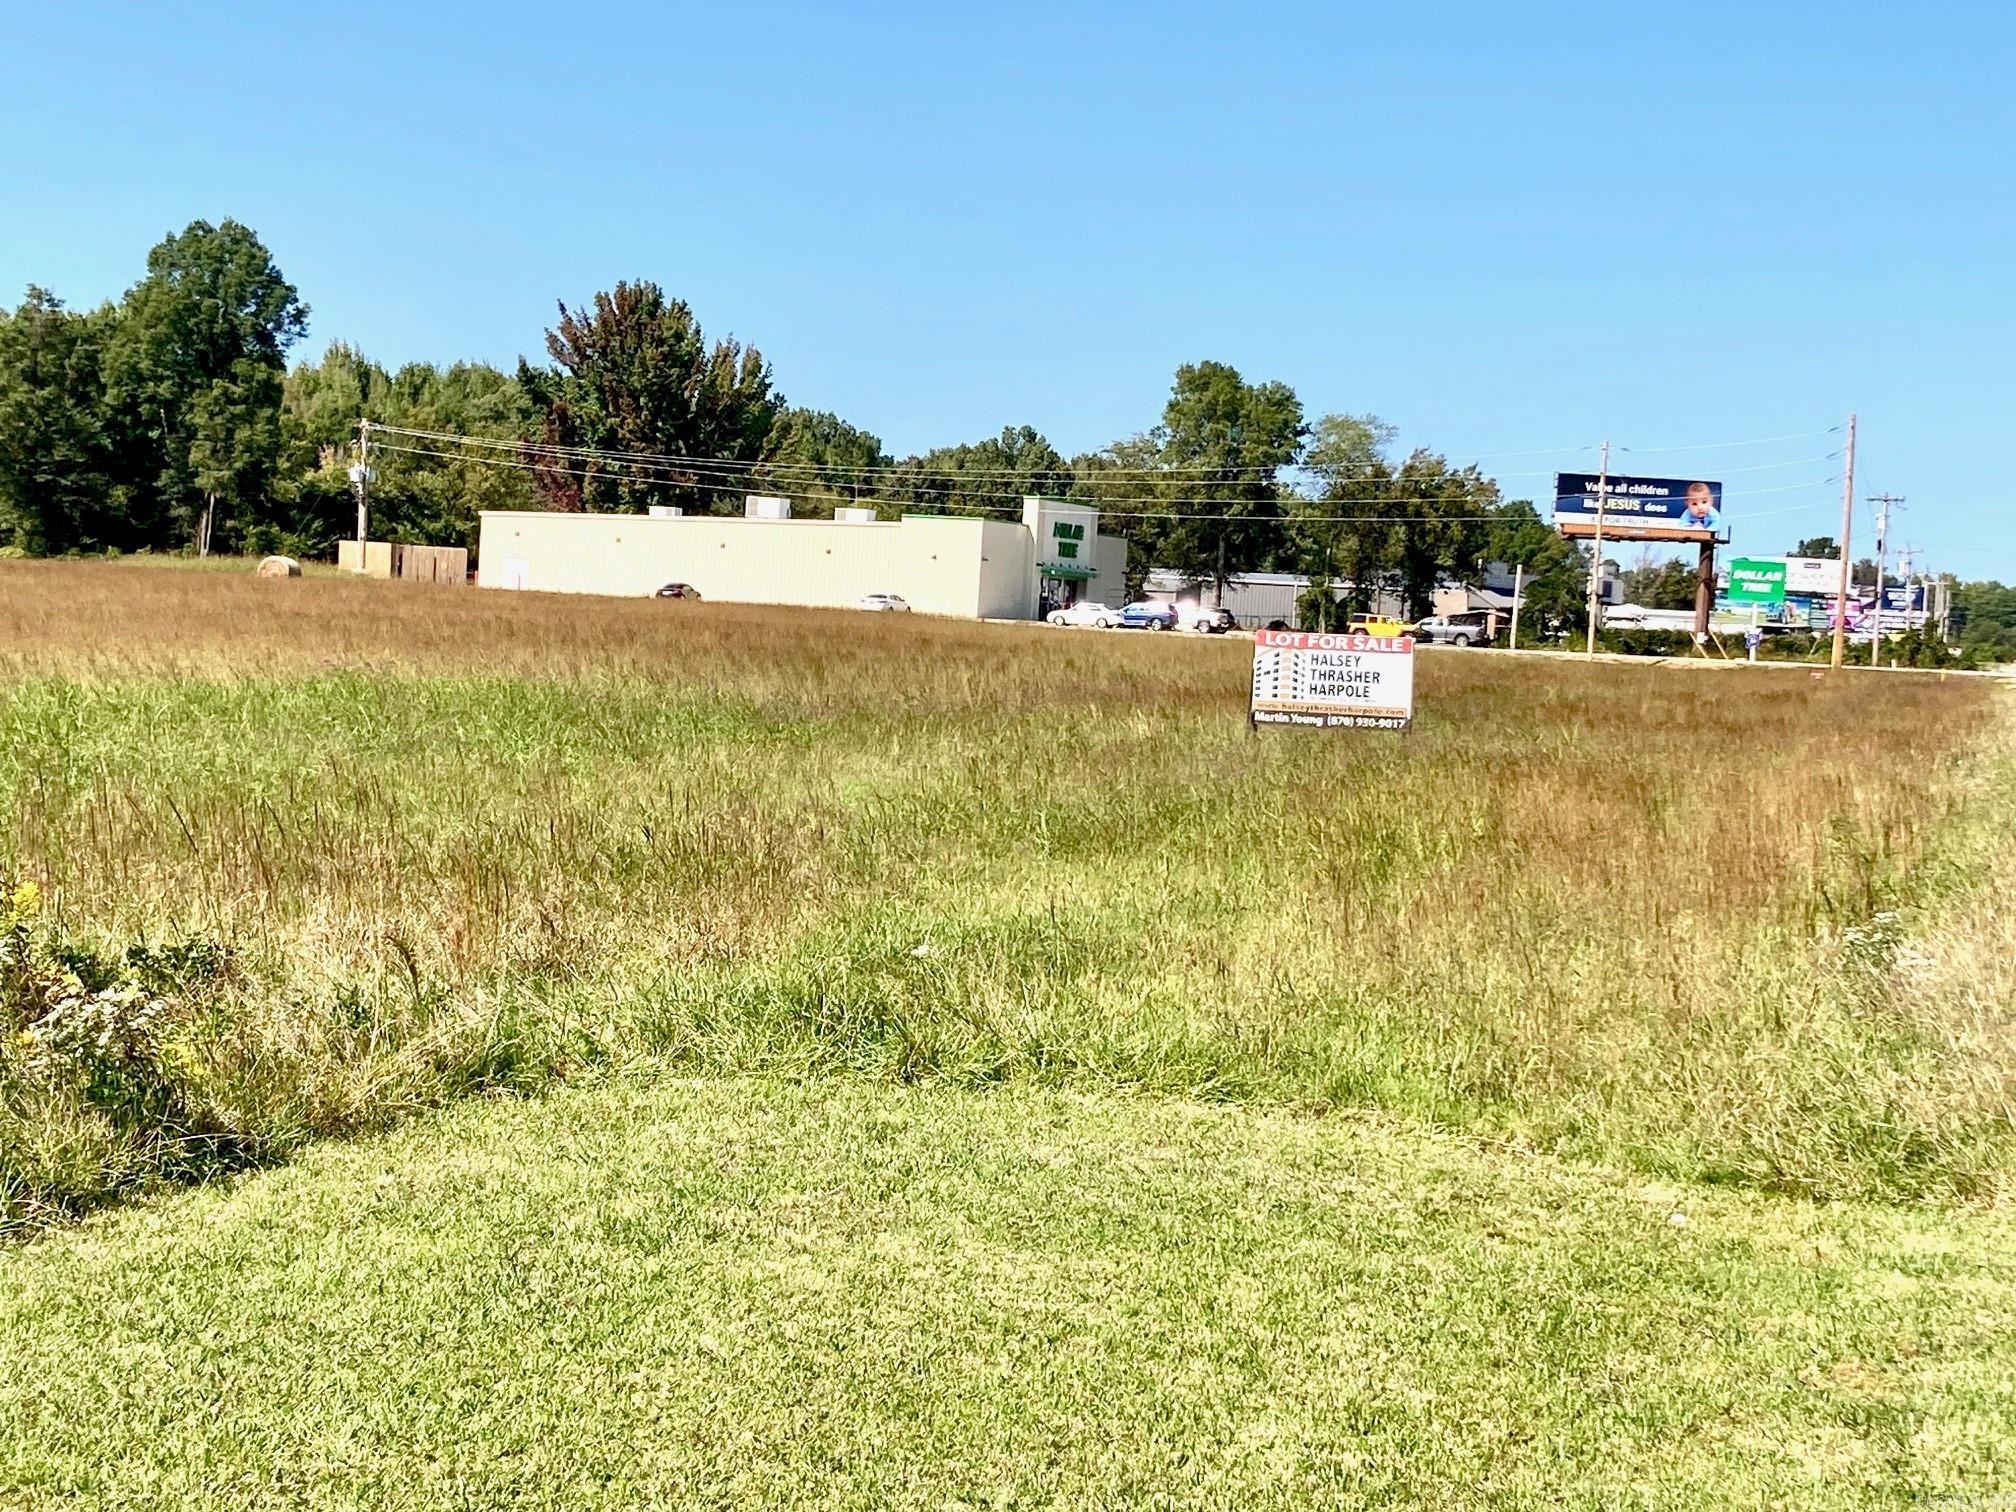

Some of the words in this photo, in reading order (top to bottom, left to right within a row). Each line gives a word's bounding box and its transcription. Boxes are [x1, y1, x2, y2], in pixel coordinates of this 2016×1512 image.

[1614, 482, 1628, 494] all
[1628, 484, 1669, 496] children
[1604, 498, 1640, 511] JESUS
[1644, 502, 1668, 513] does
[1265, 631, 1304, 648] LOT
[1307, 635, 1349, 650] FOR
[1352, 636, 1405, 652] SALE
[1310, 654, 1361, 667] HALSEY
[1310, 669, 1381, 684] THRASHER
[1309, 684, 1370, 698] HARPOLE
[1254, 710, 1290, 723] Martin
[1290, 713, 1323, 727] Young
